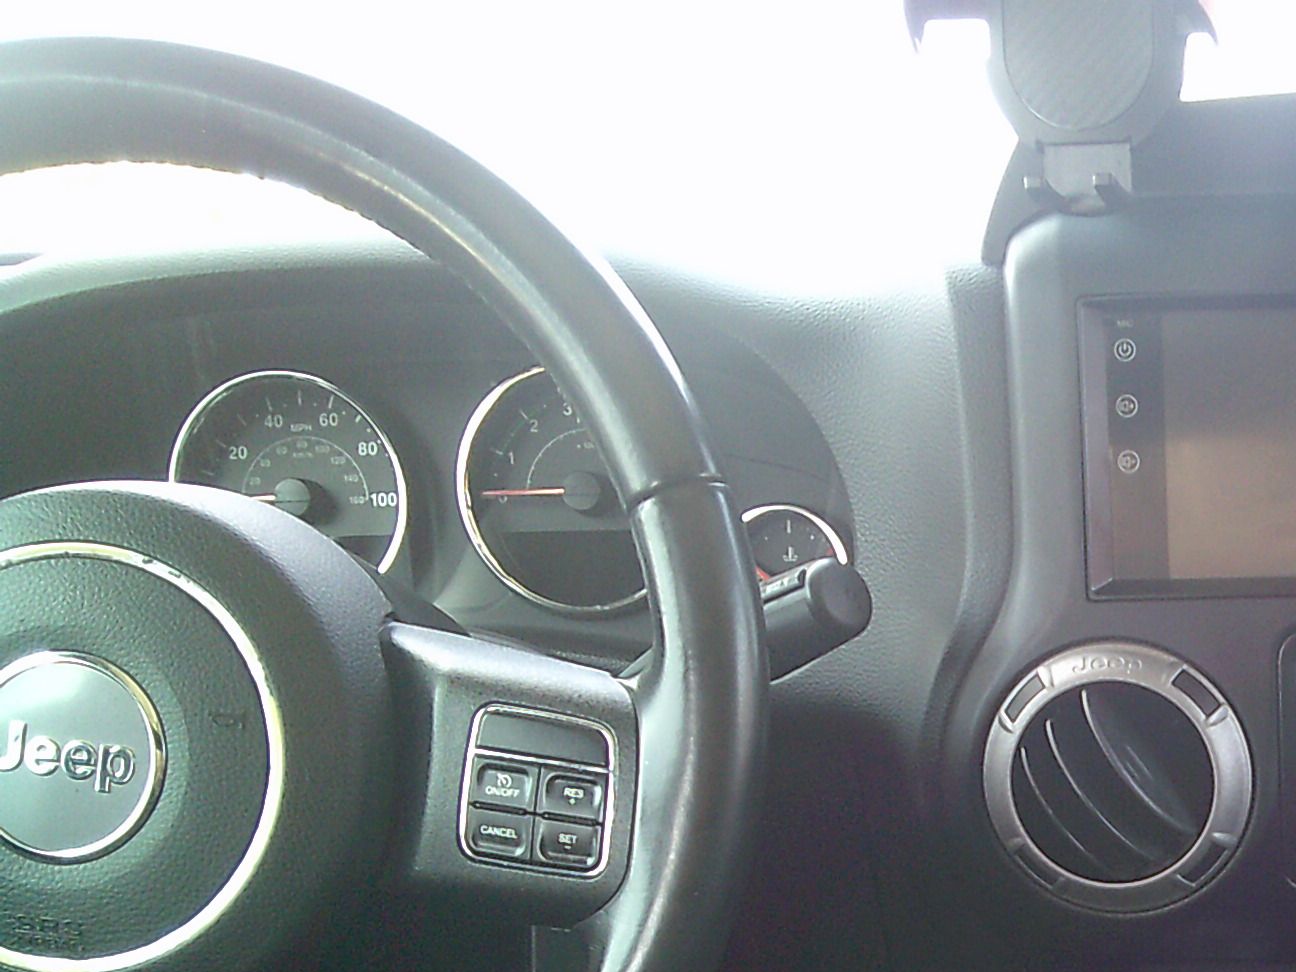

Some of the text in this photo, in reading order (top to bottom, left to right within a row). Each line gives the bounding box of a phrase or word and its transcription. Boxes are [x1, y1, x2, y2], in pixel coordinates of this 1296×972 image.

[562, 402, 573, 416] 3
[264, 414, 283, 428] 40
[319, 413, 338, 427] 60
[530, 419, 539, 433] 2
[229, 446, 247, 459] 20
[358, 441, 378, 456] 80
[508, 452, 515, 465] 1
[370, 492, 397, 507] 100
[0, 719, 136, 793] Jeep
[563, 787, 585, 799] RES
[480, 825, 518, 839] CANCEL
[558, 833, 578, 844] SET
